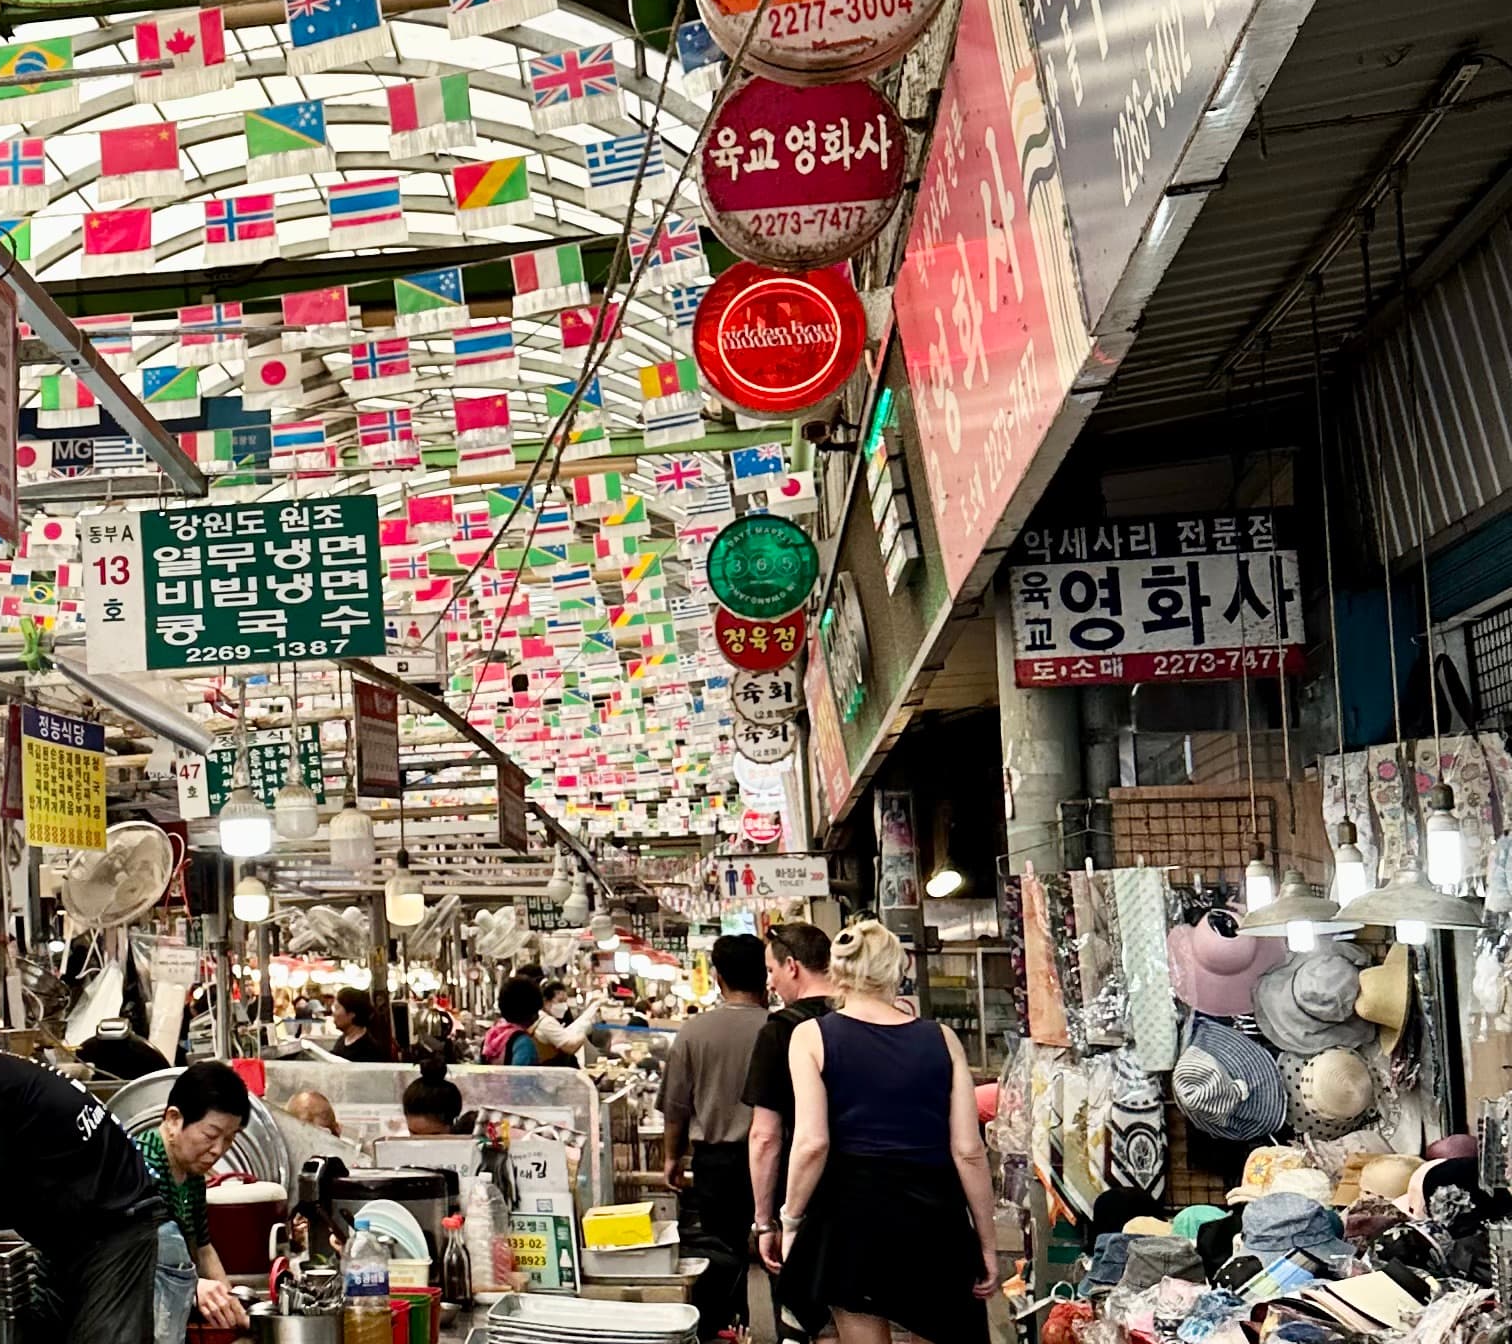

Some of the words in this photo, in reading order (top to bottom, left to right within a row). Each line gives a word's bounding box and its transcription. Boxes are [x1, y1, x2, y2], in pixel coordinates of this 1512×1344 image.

[751, 206, 867, 238] 2273-7477
[928, 126, 1024, 453] 영화사
[985, 337, 1040, 495] 2273-7477
[55, 440, 92, 460] MG
[88, 524, 119, 544] 동부
[121, 524, 135, 543] A
[169, 509, 267, 541] 강원도
[279, 504, 344, 534] 원조
[1023, 521, 1157, 564] 악세사리
[1176, 514, 1278, 553] 전문점
[92, 555, 131, 586] 13
[153, 534, 367, 578] 열무냉면
[156, 569, 370, 609] 비빔냉면
[1019, 570, 1057, 652] 육교
[1059, 555, 1294, 652] 영화사
[102, 599, 126, 623] 호
[155, 605, 371, 646] 콩국수
[186, 639, 351, 663] 2269-1387
[723, 626, 796, 653] 정육점
[1154, 648, 1289, 676] 2273-7477
[735, 681, 793, 704] 육회
[38, 715, 86, 746] 정능식당
[738, 723, 789, 744] 육회
[179, 763, 201, 780] 47
[186, 785, 199, 799] 호
[775, 867, 807, 878] 화장실
